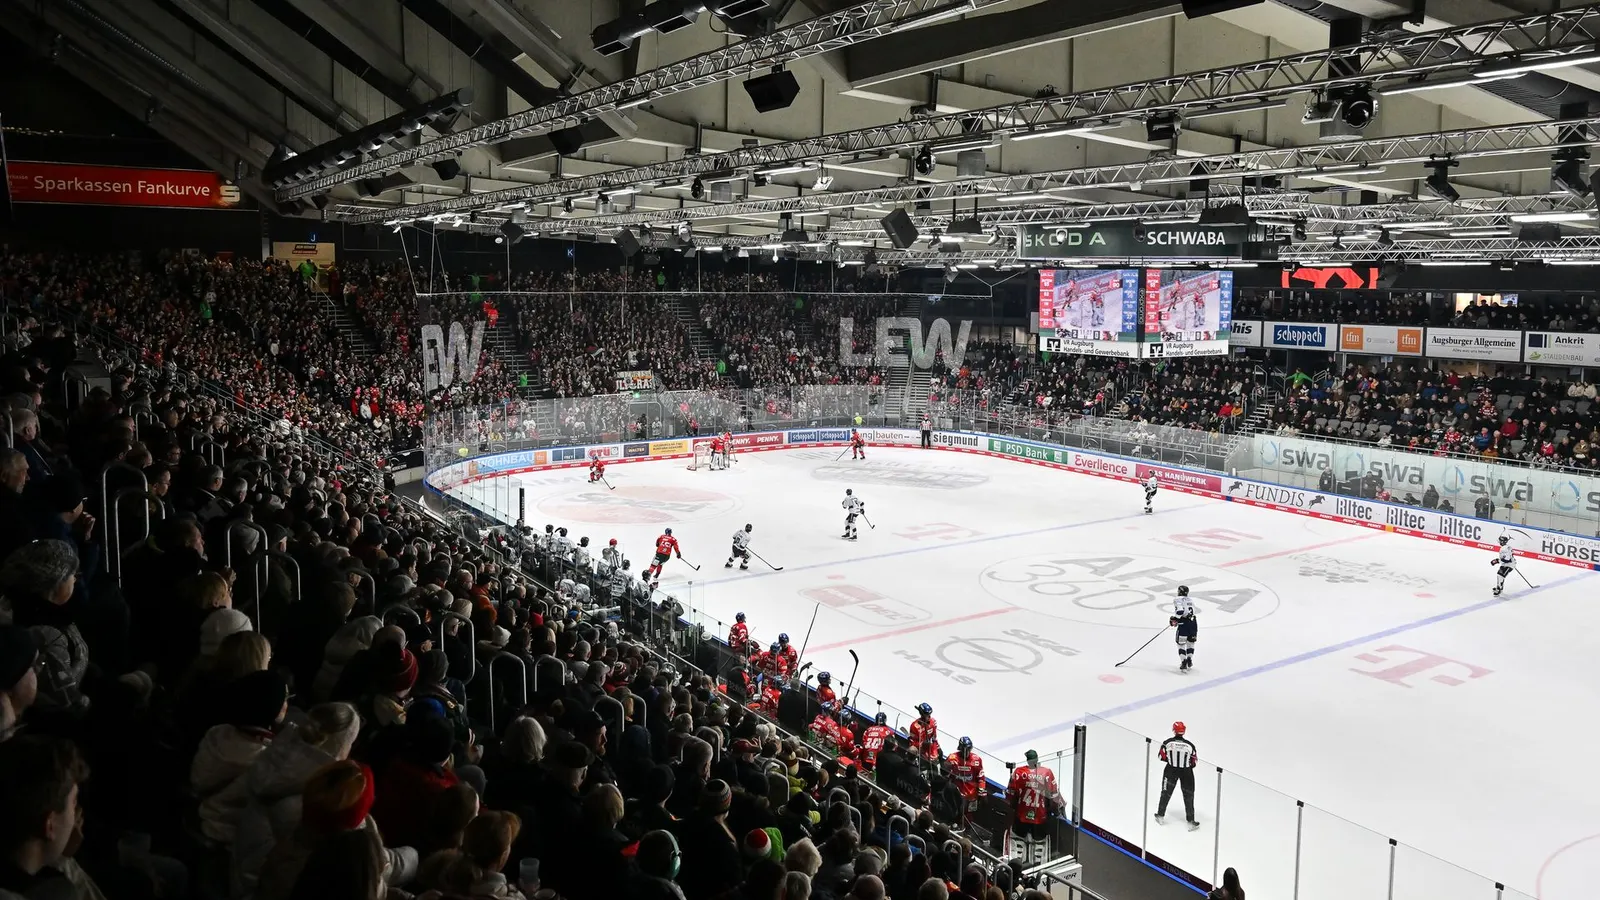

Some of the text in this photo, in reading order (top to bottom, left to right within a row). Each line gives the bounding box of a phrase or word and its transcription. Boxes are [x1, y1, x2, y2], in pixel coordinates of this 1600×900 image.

[33, 176, 211, 197] Sparkassen Fankurve
[310, 234, 316, 242] J
[1147, 231, 1225, 246] SCHWABA
[1231, 322, 1252, 335] his
[1276, 326, 1323, 345] scheppach
[840, 317, 973, 369] LEW
[1346, 331, 1360, 343] tfm
[1402, 334, 1417, 345] tfm
[1432, 336, 1516, 349] Augsburger Allgemeine
[1555, 336, 1584, 345] Ankrit
[1095, 349, 1130, 357] Gewerbebank
[1173, 342, 1194, 350] Augsburg
[1194, 348, 1223, 356] Gewerbebank
[792, 431, 816, 442] scheppach
[821, 430, 845, 441] scheppach
[934, 433, 979, 447] siegmund
[1006, 443, 1048, 460] PSD Bank
[480, 453, 534, 468] WOHNBAU
[1282, 449, 1329, 470] swa
[1370, 460, 1425, 485] swa
[1246, 484, 1305, 507] FUNDIS
[1470, 475, 1533, 502] swa
[1557, 535, 1585, 546] BUILD
[1541, 540, 1600, 563] HORSE
[1050, 556, 1261, 614] AHA
[892, 649, 977, 685] HAAS
[1097, 829, 1123, 847] TOYOTA
